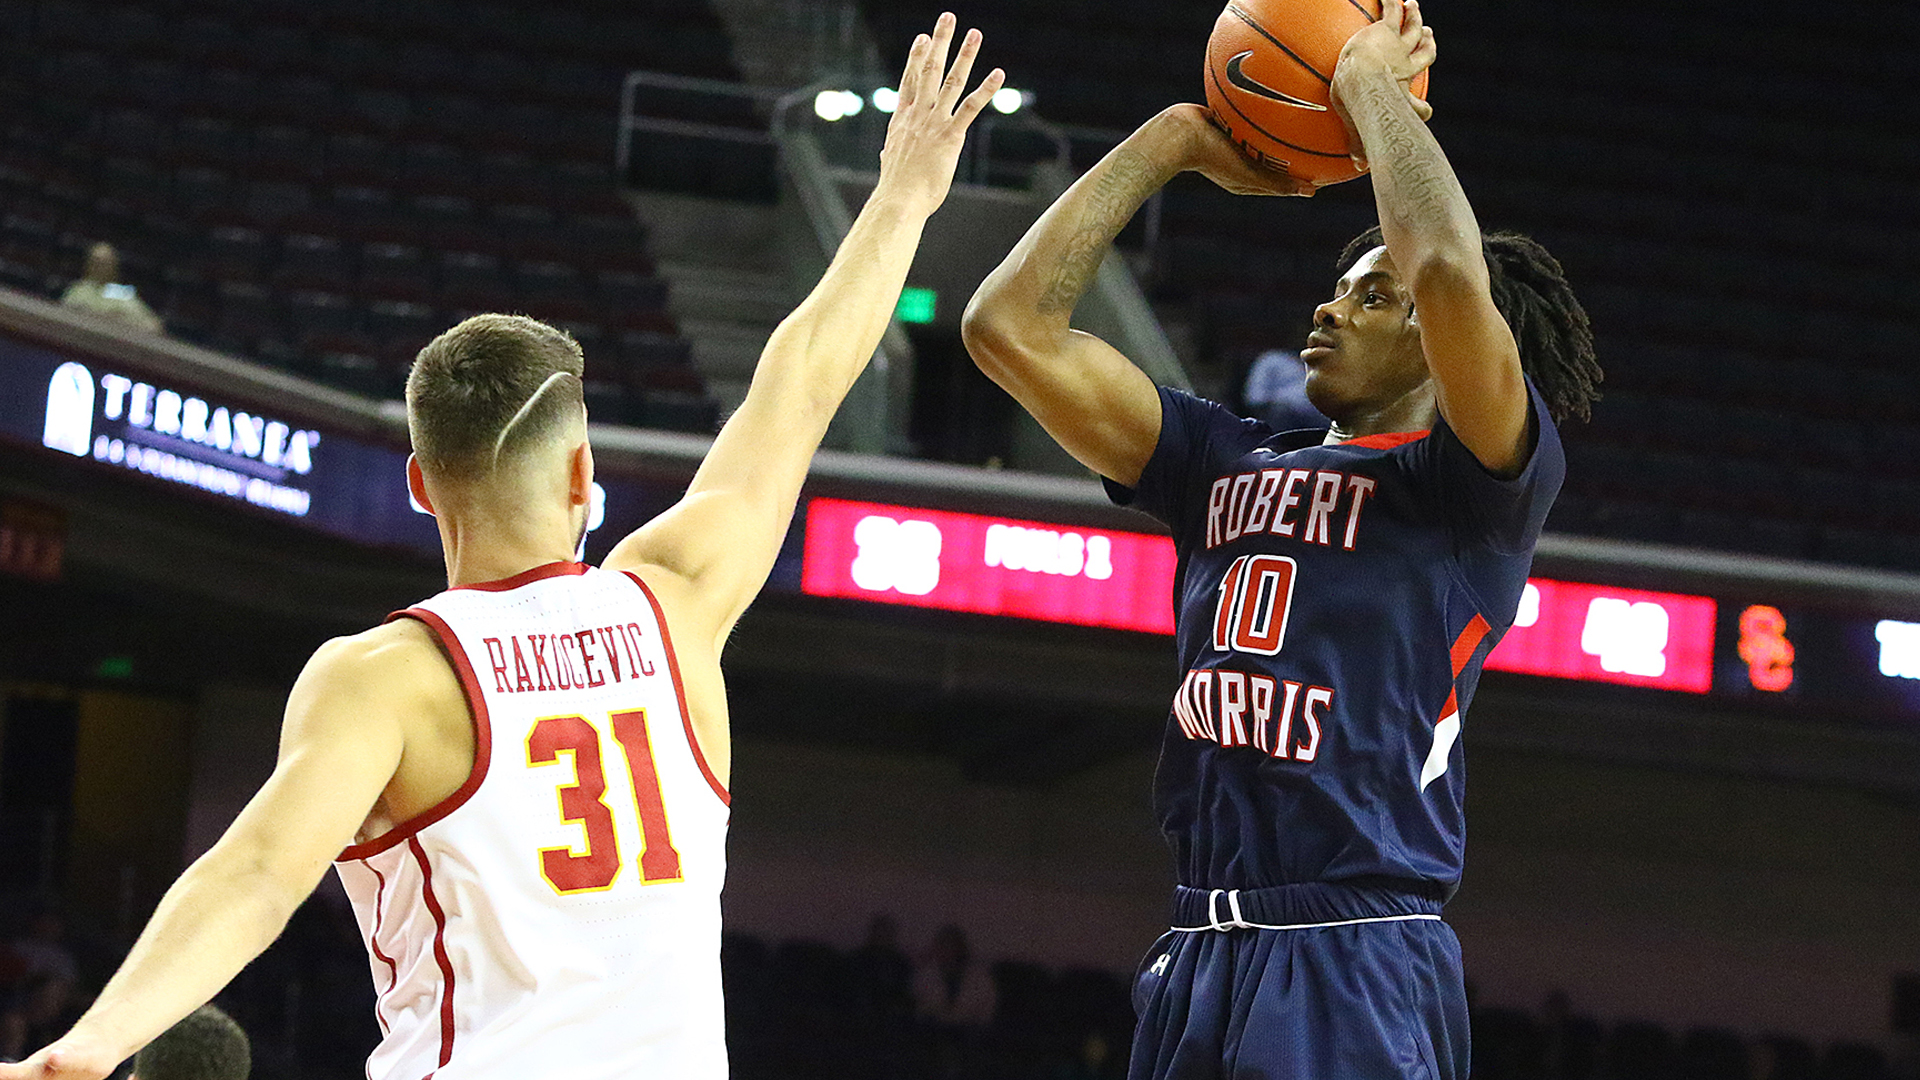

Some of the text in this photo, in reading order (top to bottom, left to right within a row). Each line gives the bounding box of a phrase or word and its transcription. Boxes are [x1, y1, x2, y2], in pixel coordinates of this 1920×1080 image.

[1206, 467, 1377, 551] ROBERT
[1212, 554, 1297, 656] 10
[483, 622, 655, 693] RAKOCEVIC
[1173, 669, 1335, 763] MORRIS
[523, 707, 685, 896] 31
